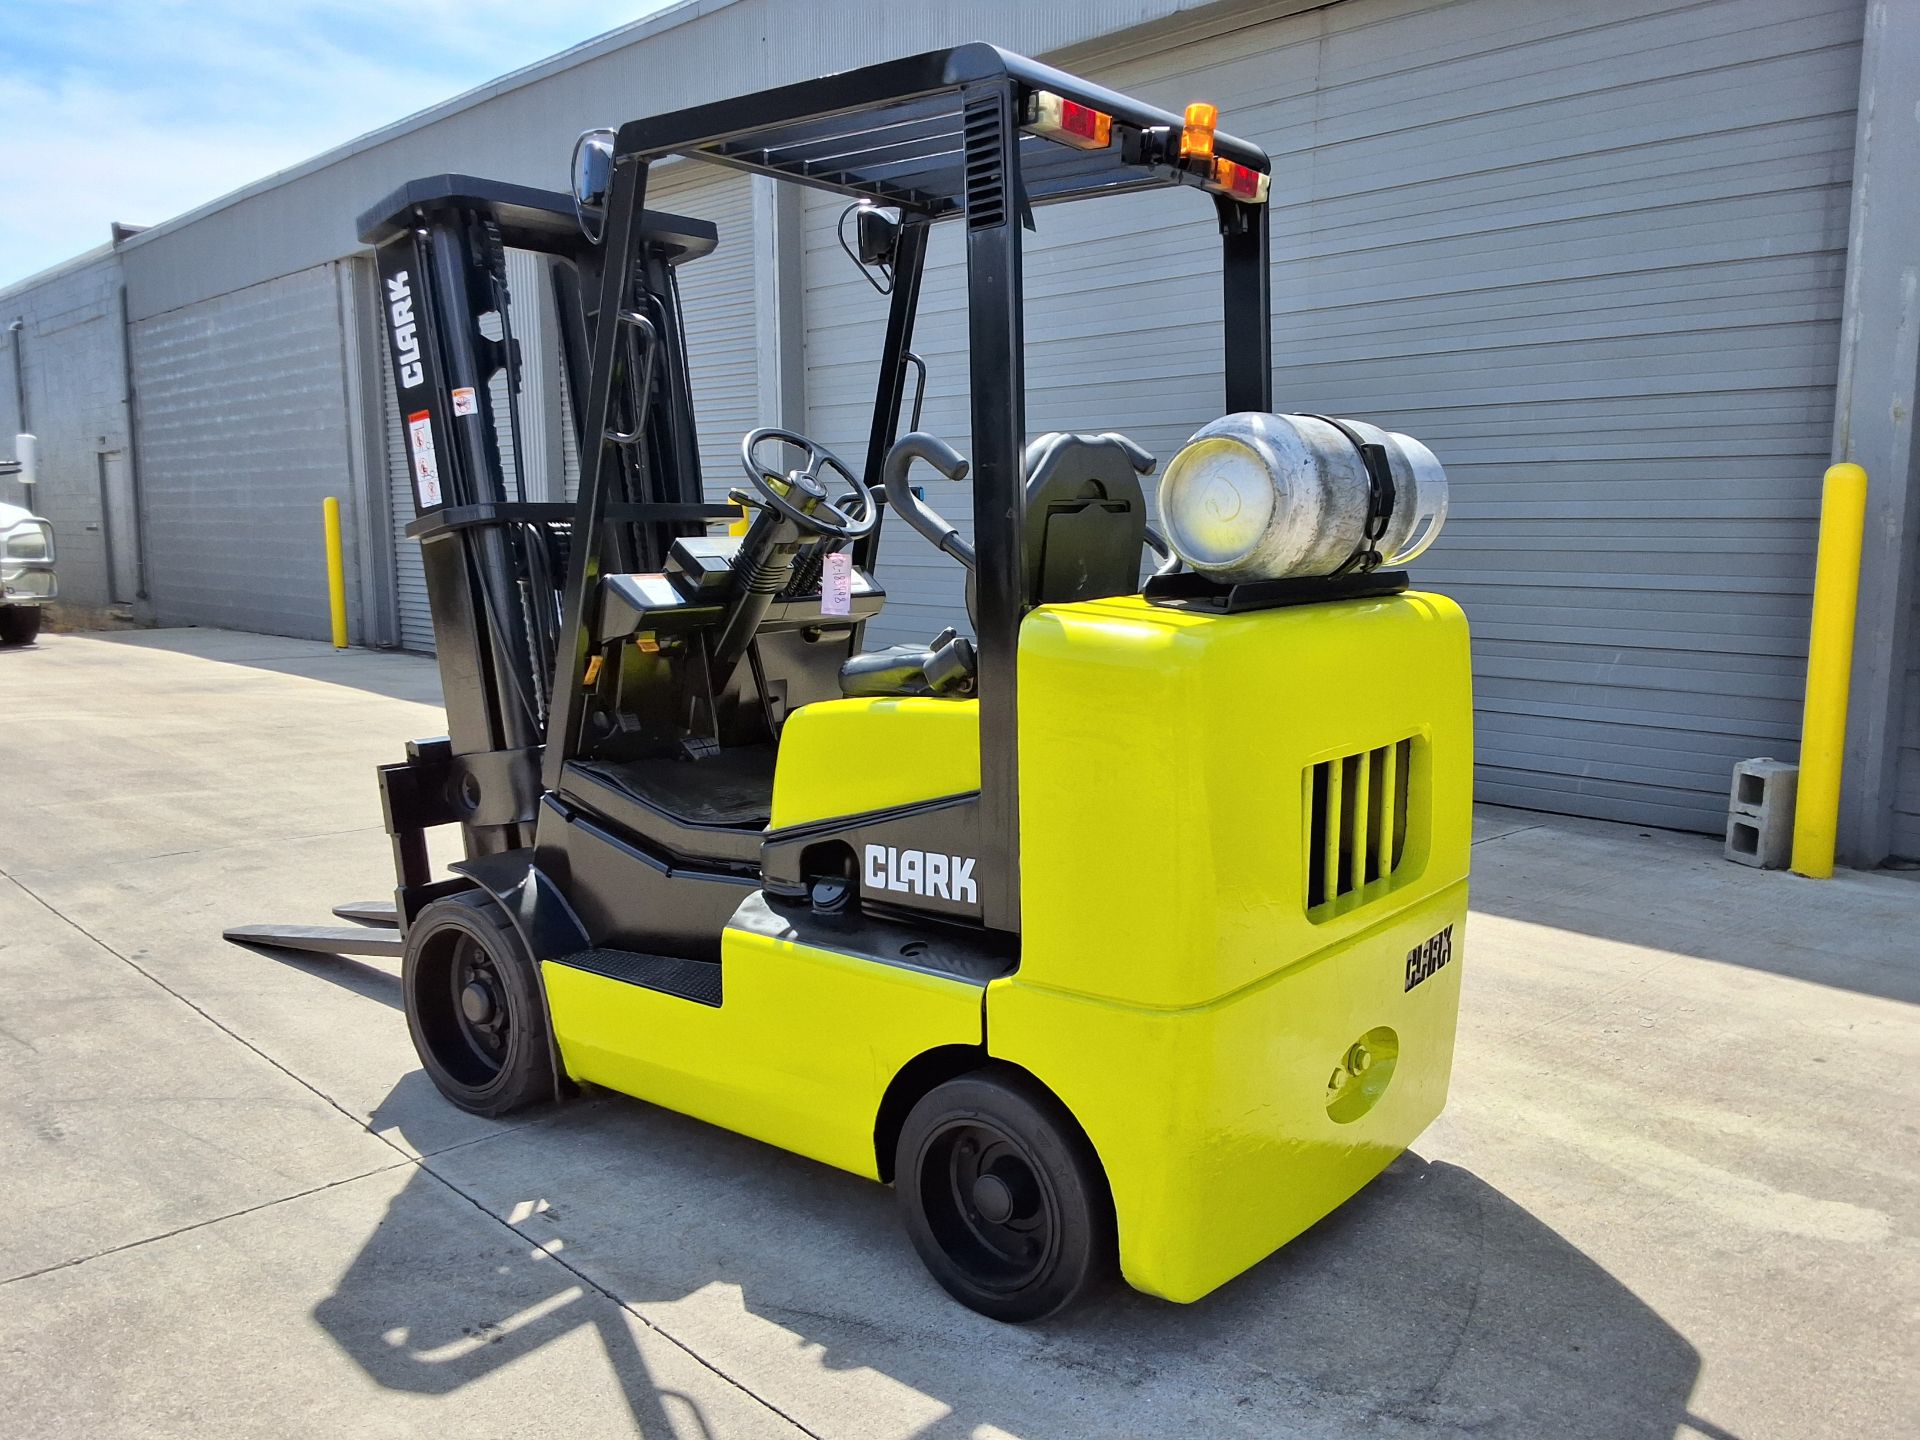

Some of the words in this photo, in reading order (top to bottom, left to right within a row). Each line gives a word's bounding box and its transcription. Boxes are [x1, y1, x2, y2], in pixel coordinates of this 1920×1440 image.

[387, 271, 424, 389] CLARK
[865, 844, 977, 904] CLARK
[1404, 923, 1454, 993] CLARK
